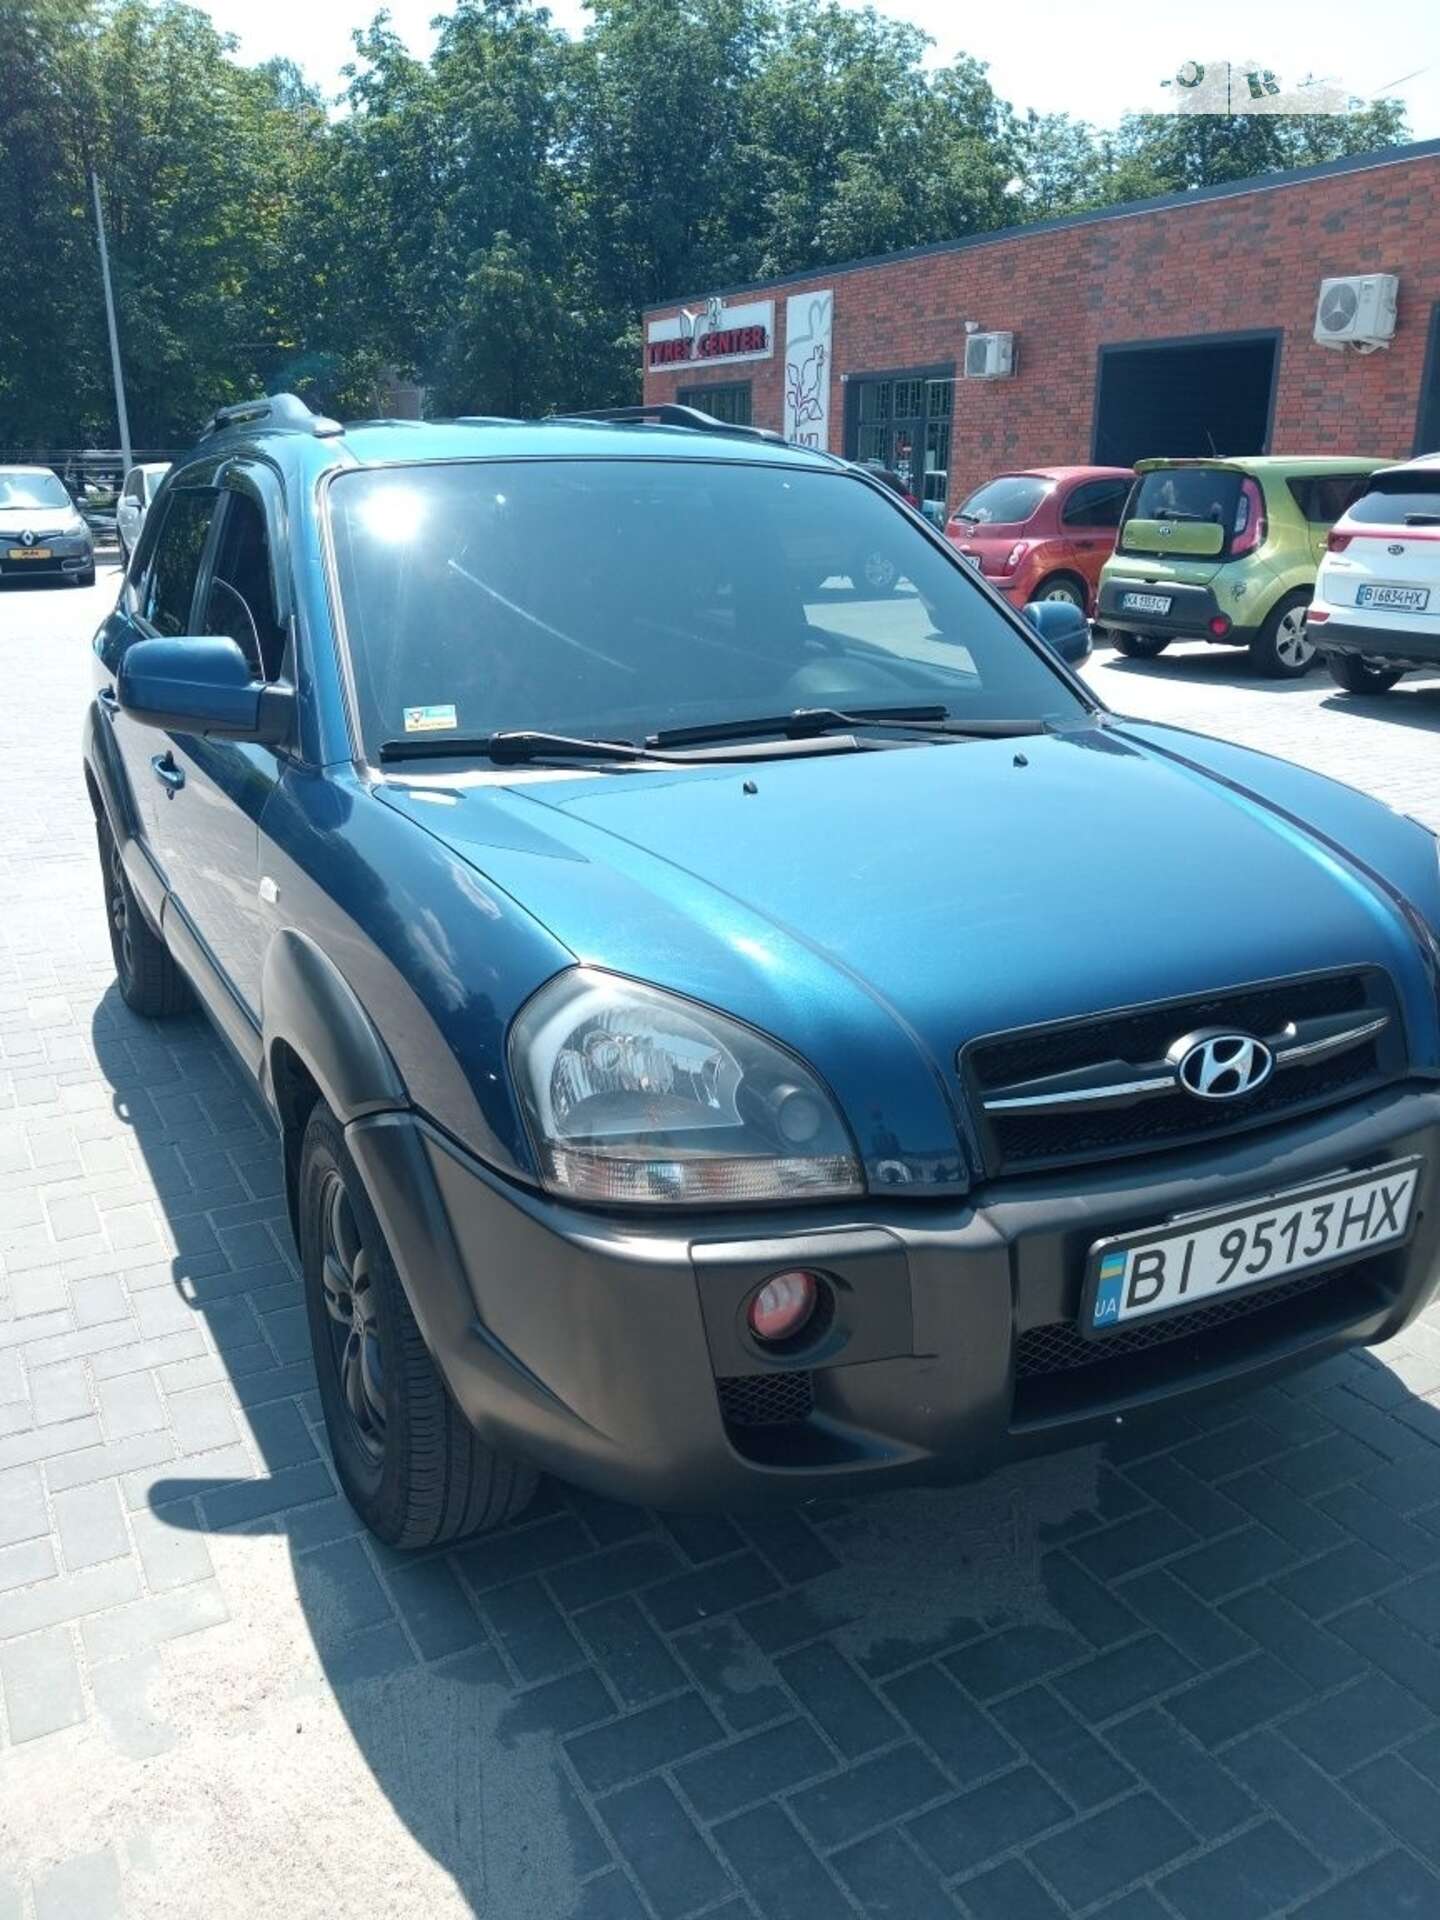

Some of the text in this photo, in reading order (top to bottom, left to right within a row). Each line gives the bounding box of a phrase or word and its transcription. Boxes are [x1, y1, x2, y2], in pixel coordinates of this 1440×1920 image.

[699, 324, 766, 359] CENTER
[1125, 1238, 1196, 1309] BI
[1094, 1297, 1117, 1318] UA
